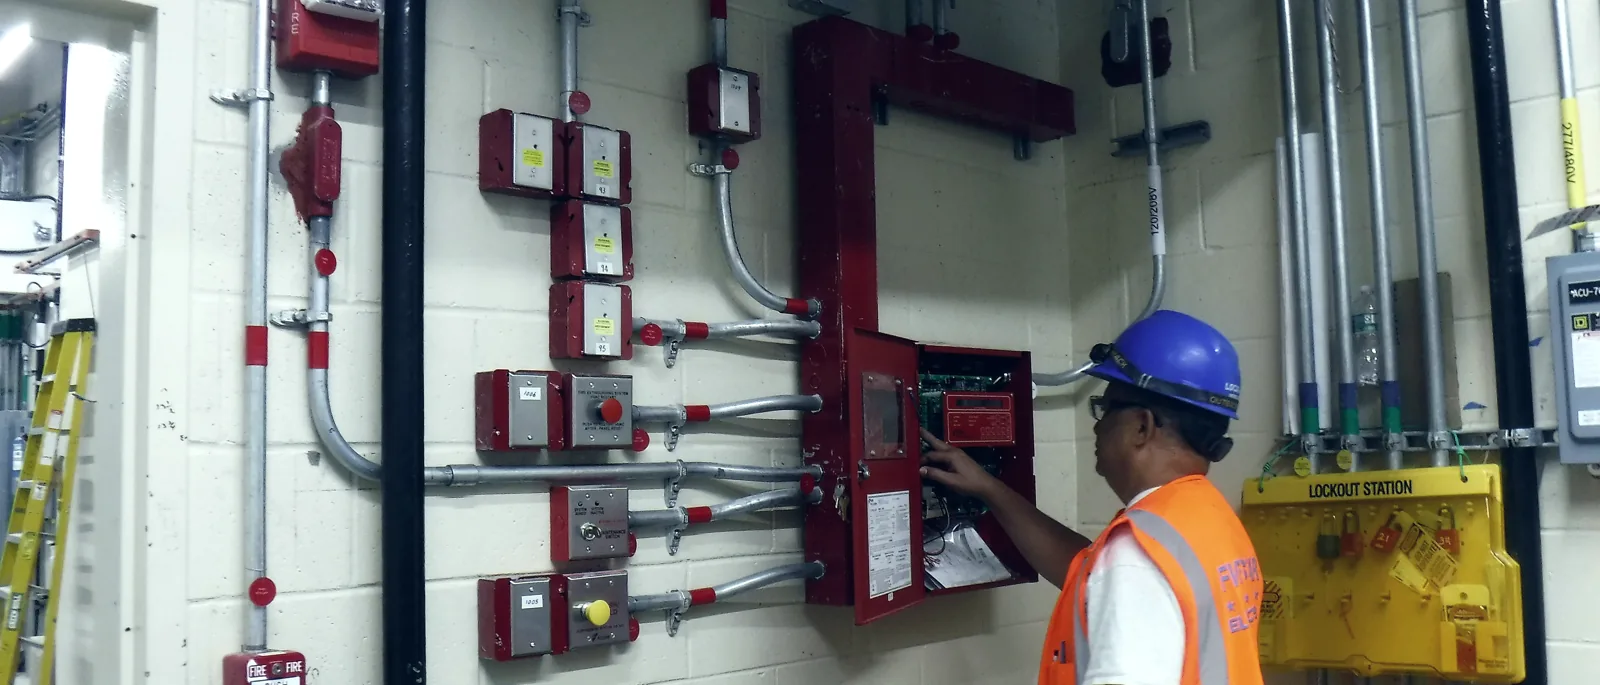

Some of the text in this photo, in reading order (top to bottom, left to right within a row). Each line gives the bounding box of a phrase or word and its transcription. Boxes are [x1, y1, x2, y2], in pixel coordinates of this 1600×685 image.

[291, 0, 300, 34] IRE
[1561, 122, 1576, 184] 277/480V
[1148, 187, 1159, 236] 120/208V
[598, 344, 607, 353] 95
[1309, 480, 1413, 498] LOCKOUT STATION
[249, 665, 267, 677] FIRE
[286, 661, 303, 673] FIRE
